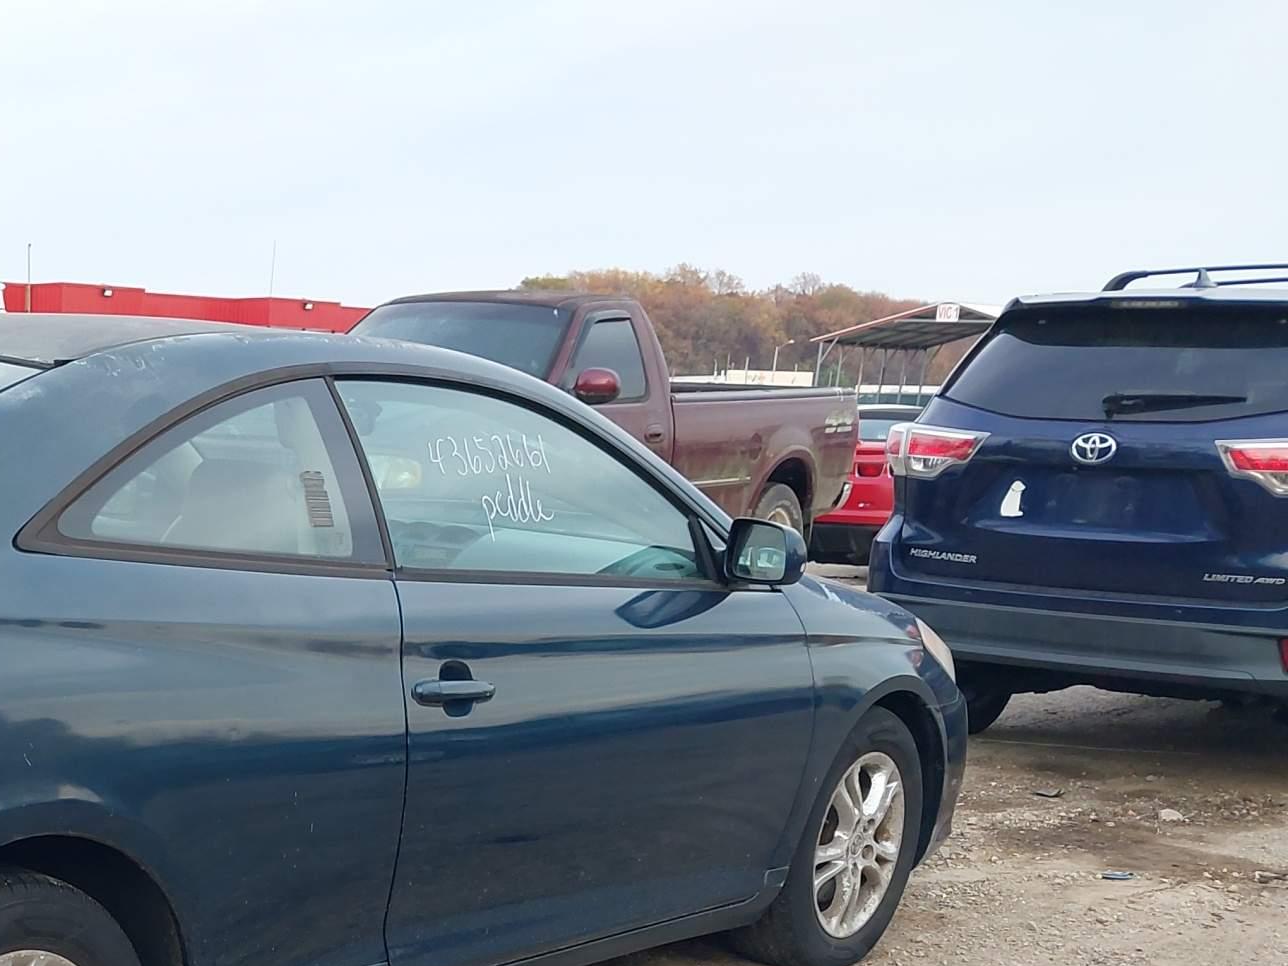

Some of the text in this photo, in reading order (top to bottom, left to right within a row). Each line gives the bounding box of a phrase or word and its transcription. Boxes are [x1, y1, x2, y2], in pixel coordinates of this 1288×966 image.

[428, 434, 551, 476] 43652661
[909, 547, 977, 563] HIGHLANDER
[1203, 573, 1286, 585] LIMITED AWD
